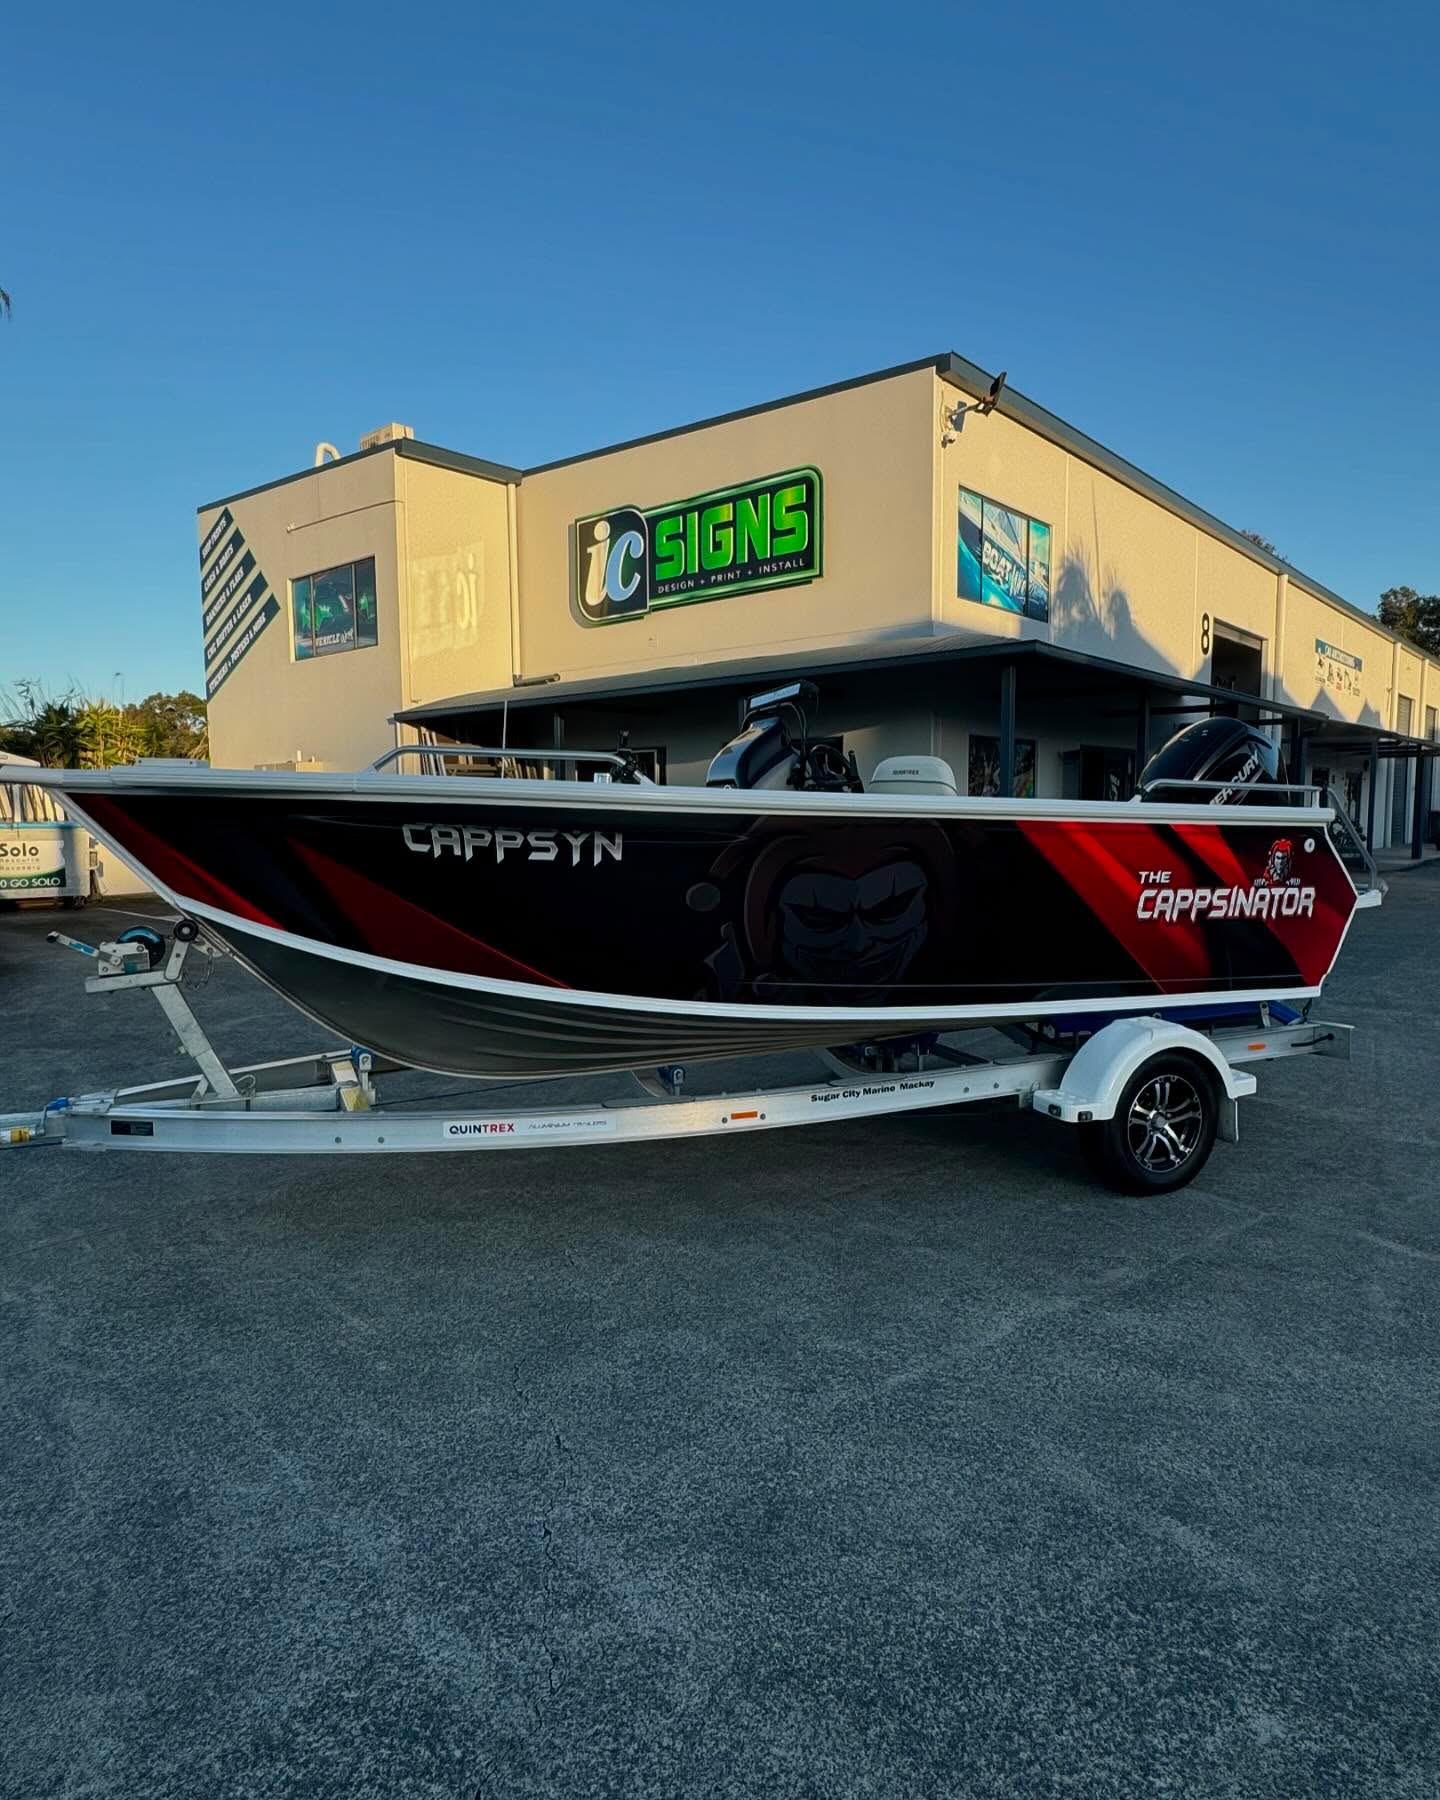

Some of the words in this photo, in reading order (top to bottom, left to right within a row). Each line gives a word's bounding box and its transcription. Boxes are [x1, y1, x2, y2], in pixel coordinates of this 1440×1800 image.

[655, 484, 807, 581] SIGNS
[657, 579, 695, 594] DESIGN
[710, 570, 741, 584] PRINT
[758, 558, 806, 574] INSTALL
[982, 540, 1012, 581] BOAT
[1201, 612, 1210, 656] 8
[0, 842, 40, 857] Solo
[402, 823, 622, 867] CAPPSYN
[10, 879, 29, 888] GO
[31, 877, 60, 887] SOLO
[1138, 870, 1172, 884] THE
[1137, 884, 1316, 923] CAPPSINATOR
[811, 1092, 841, 1103] Sugar
[842, 1088, 861, 1099] City
[862, 1084, 896, 1096] Marine
[899, 1079, 935, 1090] Mackay
[449, 1123, 515, 1135] QUINTREX
